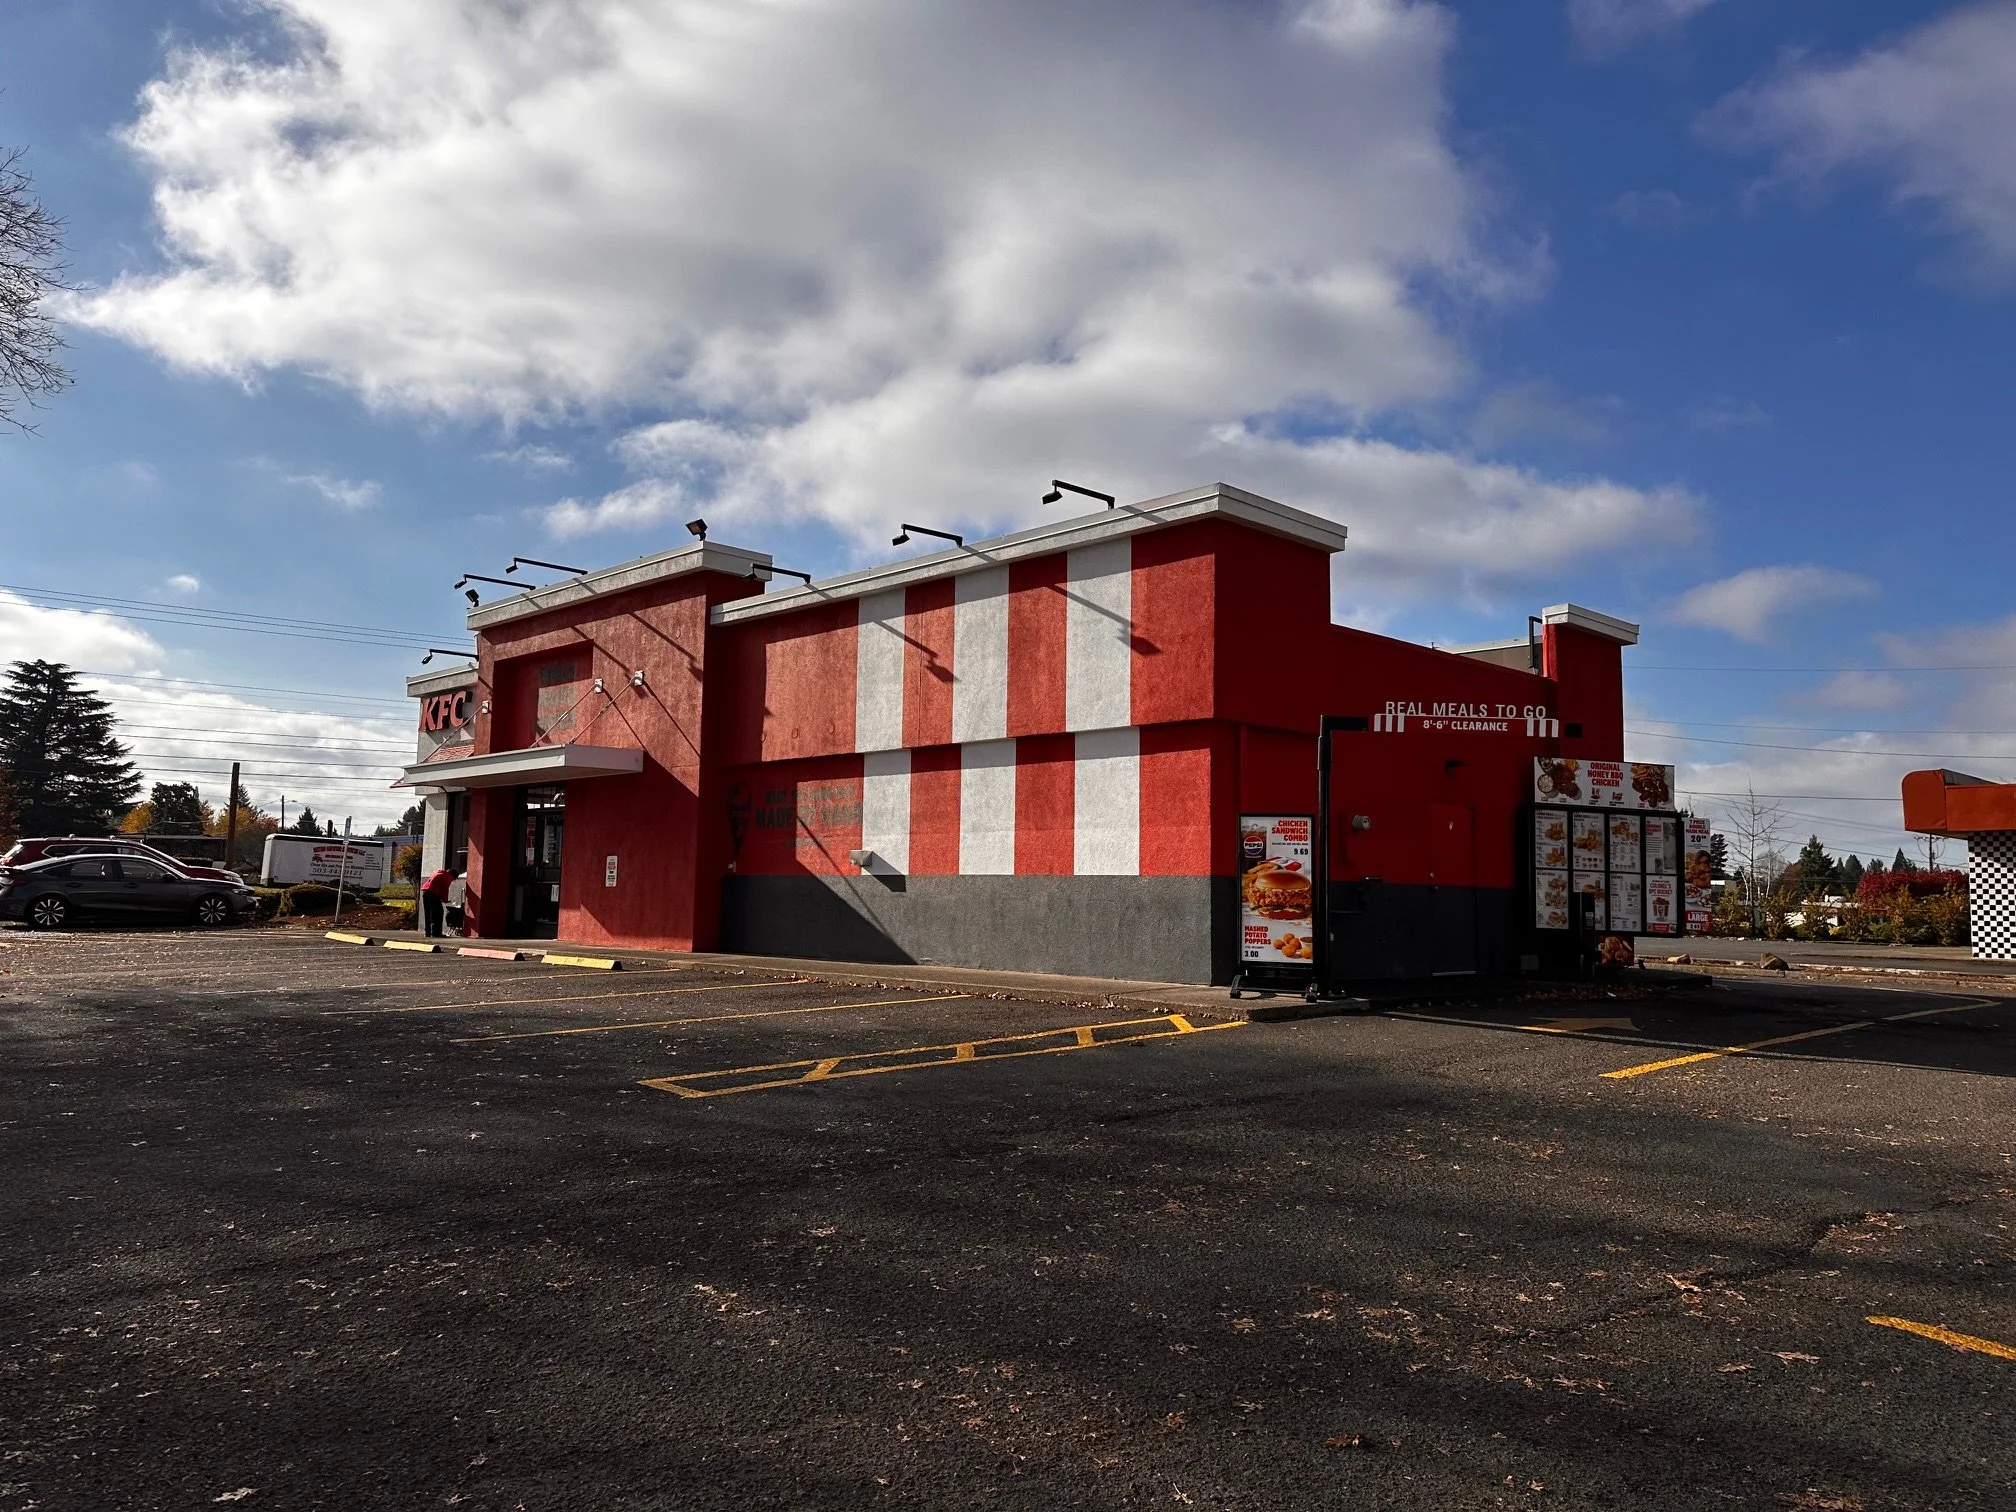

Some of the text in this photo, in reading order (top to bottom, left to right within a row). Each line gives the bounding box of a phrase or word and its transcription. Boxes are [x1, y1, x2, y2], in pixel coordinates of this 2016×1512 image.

[419, 691, 467, 733] KFC
[1385, 701, 1546, 719] REAL MEALS TO GO
[1451, 720, 1508, 731] CLEARANCE
[1590, 762, 1620, 772] ORIGINAL
[1587, 769, 1624, 781] HONEY BBQ
[1591, 778, 1620, 788] CHICKEN
[1271, 827, 1308, 835] SANDWICH
[1283, 834, 1308, 842] COMBO
[1687, 913, 1709, 922] LARGE
[1244, 925, 1268, 933] MASHED
